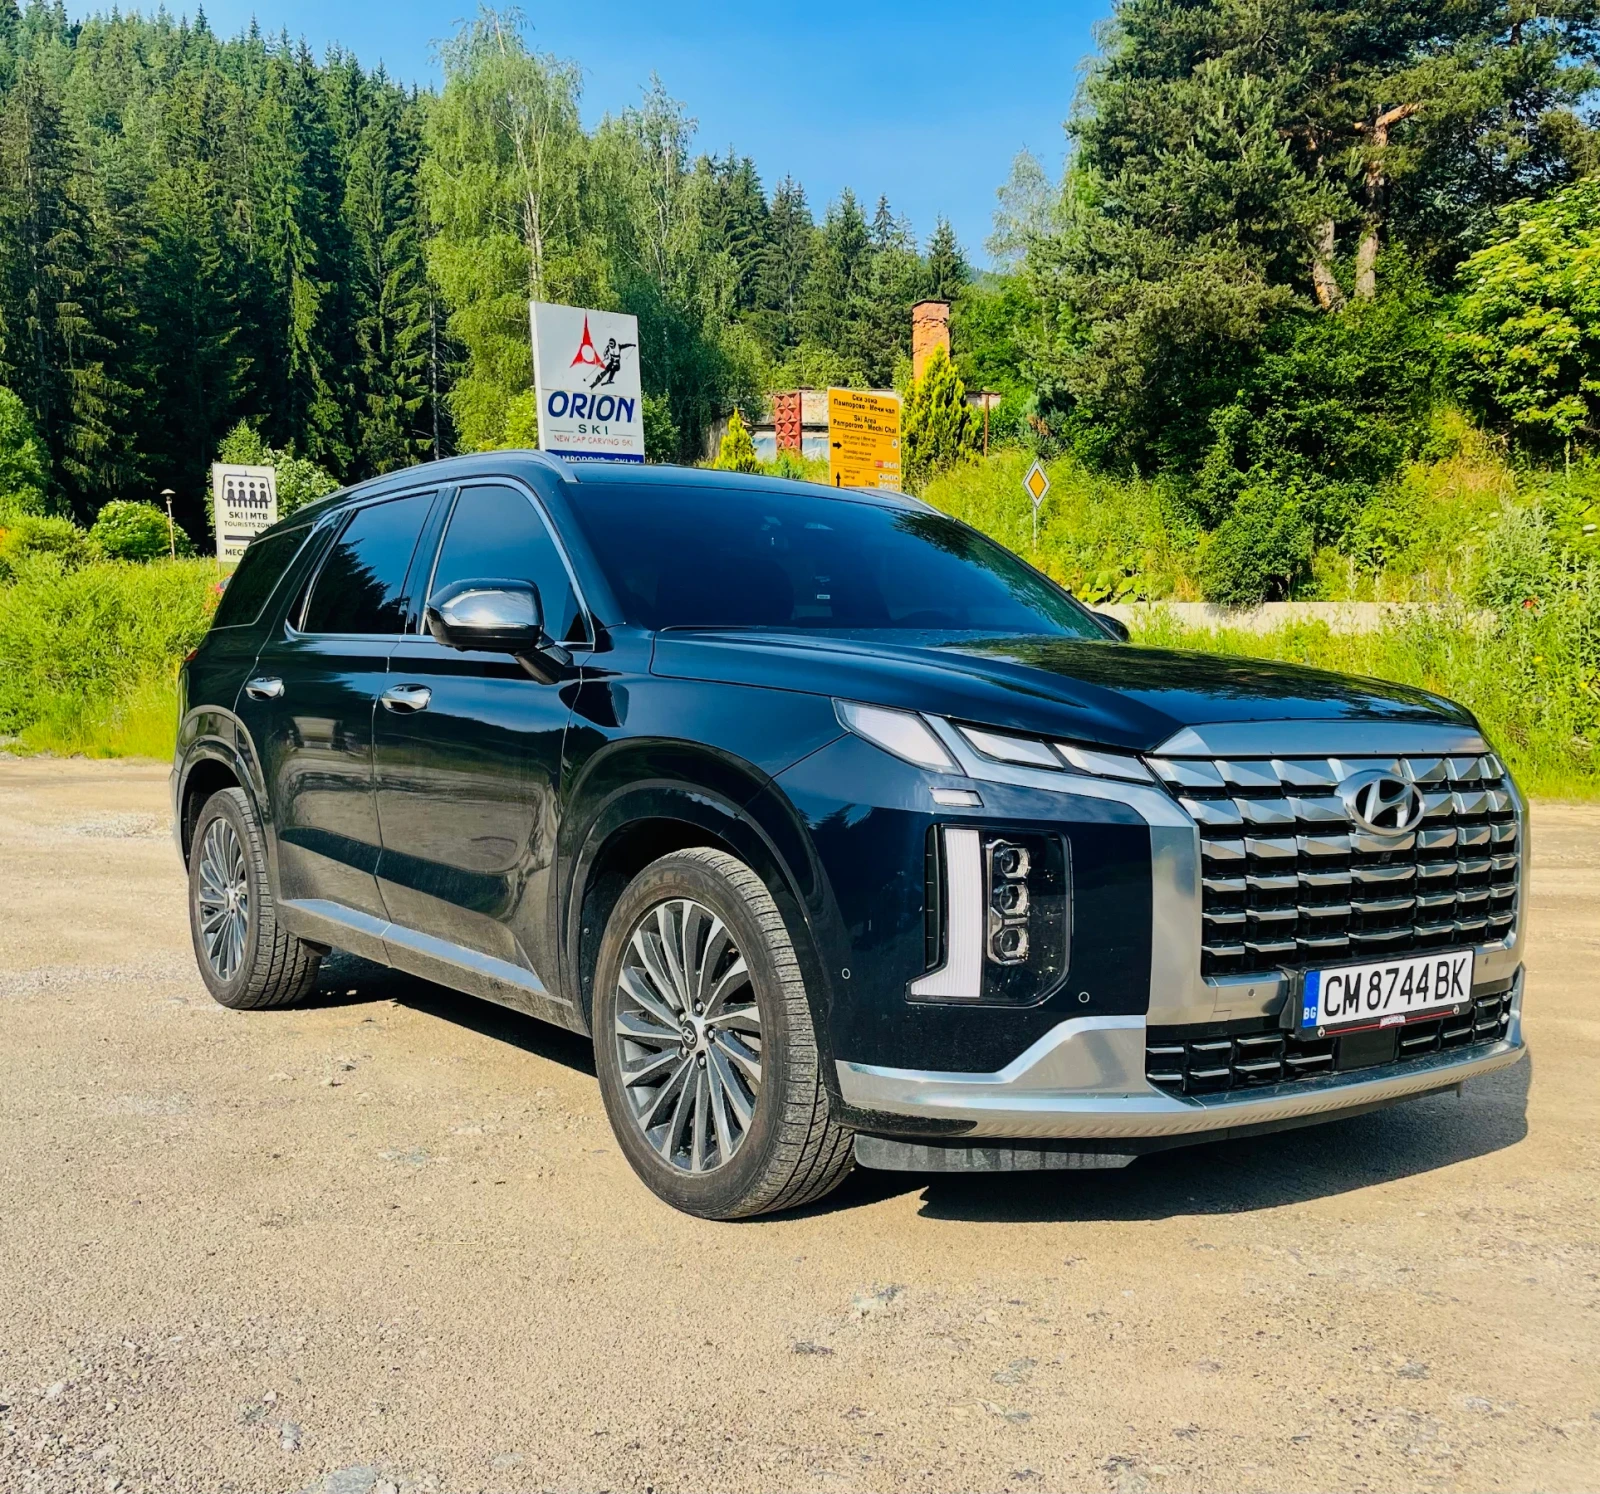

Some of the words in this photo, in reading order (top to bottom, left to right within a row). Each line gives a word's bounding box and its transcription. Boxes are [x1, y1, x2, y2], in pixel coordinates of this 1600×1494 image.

[547, 390, 635, 423] ORION
[833, 398, 866, 410] Пампорово
[853, 414, 863, 422] Ski
[864, 416, 877, 424] Area
[578, 424, 608, 435] SKI
[884, 426, 897, 434] Chal
[554, 435, 570, 443] NEW
[588, 437, 619, 446] CARVING
[621, 439, 633, 447] SKI
[228, 511, 243, 519] SKI
[1323, 972, 1362, 1017] CM
[1367, 963, 1430, 1011] 8744
[1434, 957, 1467, 1000] BK
[1303, 1006, 1317, 1019] BG
